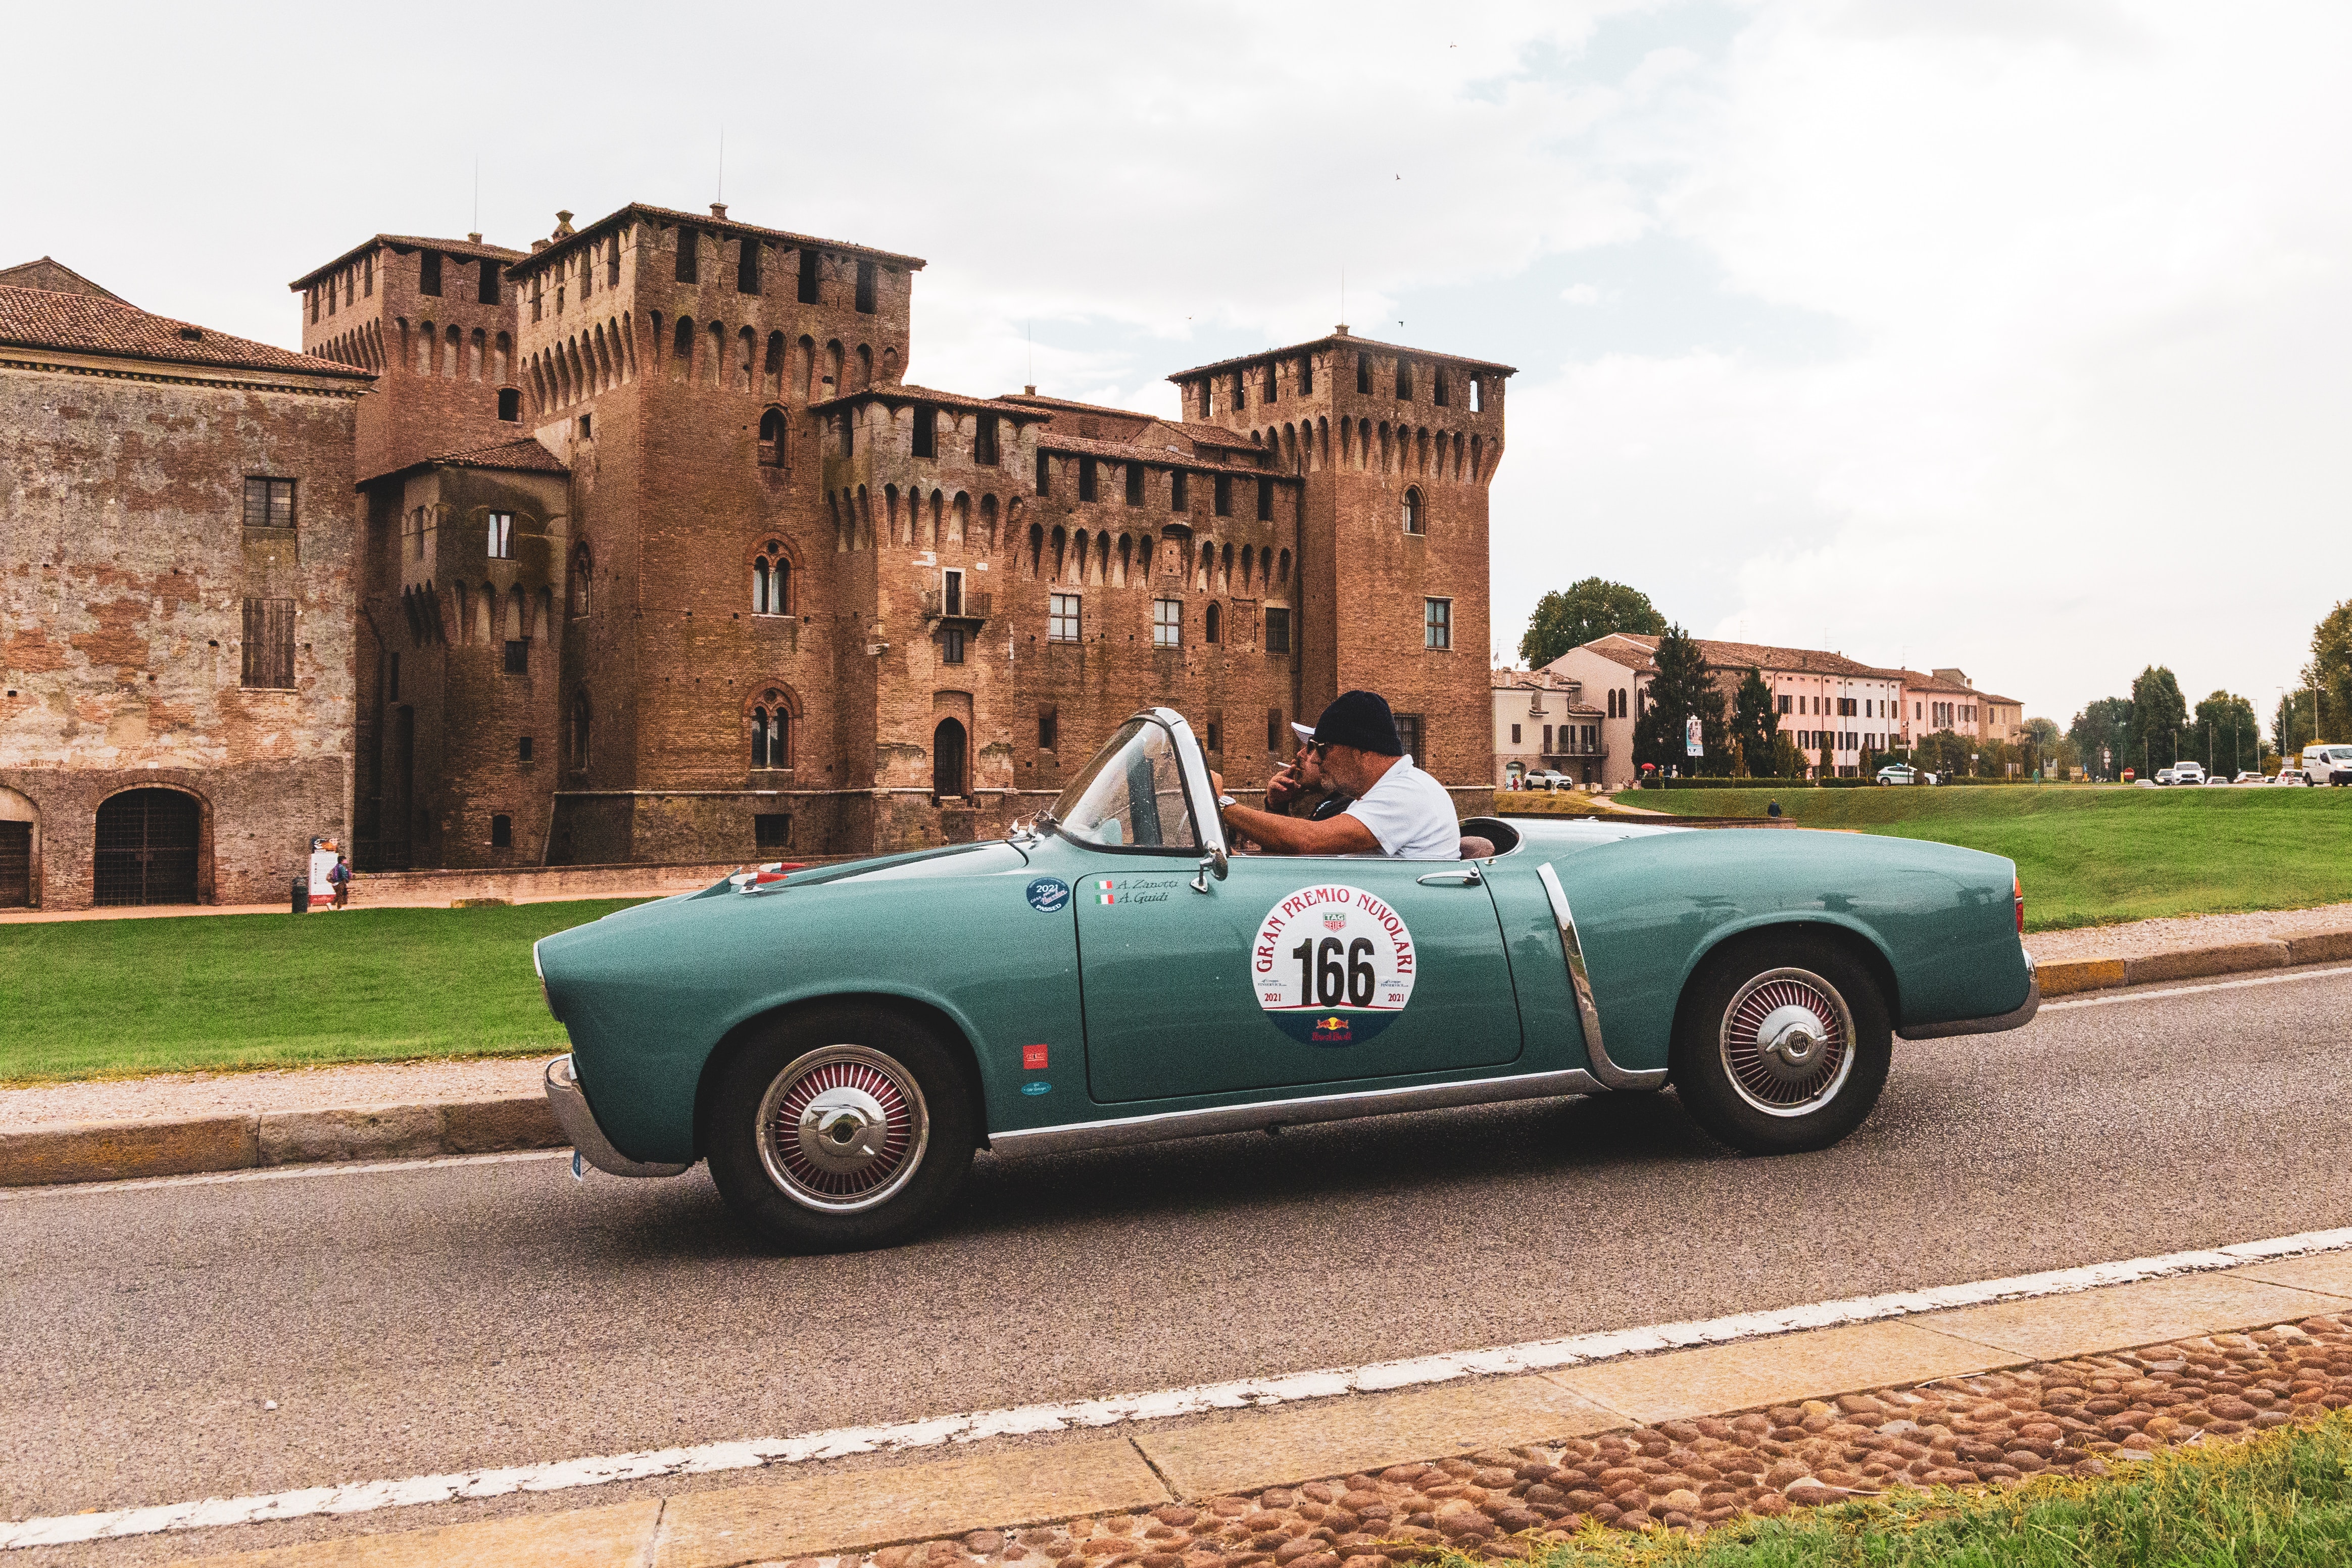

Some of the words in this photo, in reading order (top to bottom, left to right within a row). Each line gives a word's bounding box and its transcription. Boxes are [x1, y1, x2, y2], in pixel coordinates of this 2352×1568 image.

[1036, 884, 1058, 893] 2021
[1036, 903, 1062, 912] PASSED
[1325, 921, 1344, 930] HEUER
[1257, 916, 1286, 972] GRAN
[1281, 888, 1350, 918] PREMIO
[1356, 894, 1412, 974] NUVOLARI
[1293, 937, 1375, 1008] 166
[1264, 993, 1281, 1002] 2021
[1388, 993, 1404, 1002] 2021
